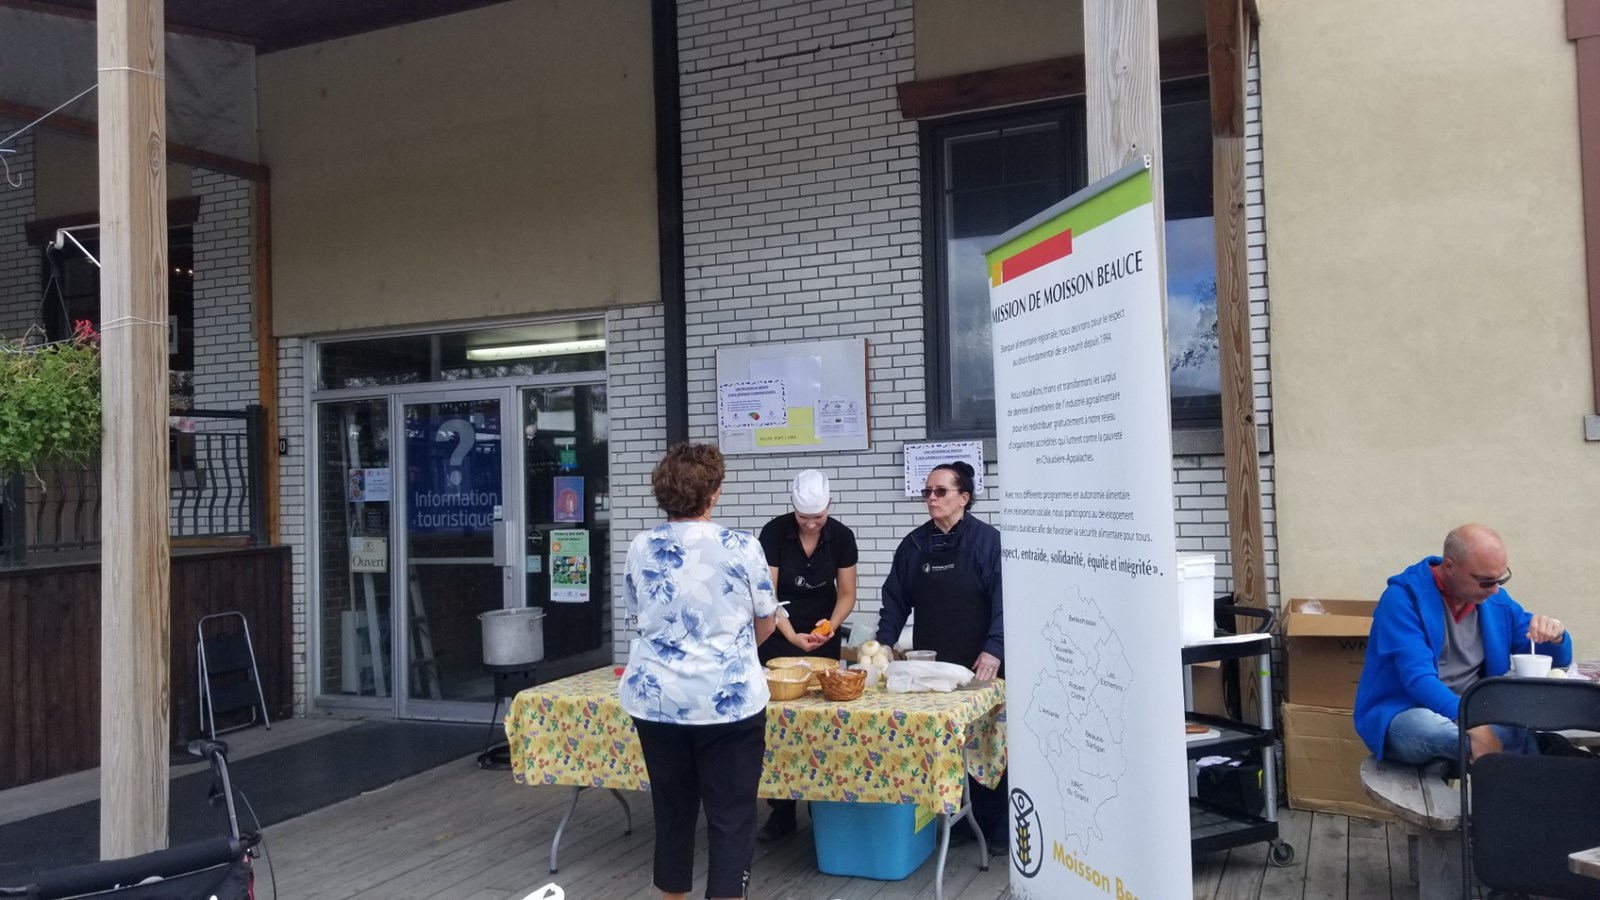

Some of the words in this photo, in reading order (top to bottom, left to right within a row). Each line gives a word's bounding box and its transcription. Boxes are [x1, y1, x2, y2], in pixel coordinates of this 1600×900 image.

[992, 297, 1026, 324] MISSION
[1028, 290, 1041, 312] DE
[1043, 270, 1094, 307] MOISSON
[1097, 250, 1143, 288] BEAUCE
[1015, 336, 1037, 349] alimentaire
[1058, 326, 1070, 336] nous
[1091, 317, 1102, 328] pour
[1103, 313, 1107, 323] le
[1107, 309, 1125, 322] respect
[1055, 346, 1061, 356] de
[1084, 336, 1099, 349] depuis
[1100, 371, 1116, 384] surplus
[1007, 409, 1013, 417] de
[1055, 400, 1061, 410] de
[1012, 425, 1022, 434] pour
[1053, 417, 1084, 430] gratuitement
[1088, 414, 1100, 423] notre
[1066, 435, 1082, 445] luttent
[1083, 435, 1097, 444] contre
[415, 489, 498, 507] Information
[1005, 491, 1014, 499] Avec
[1043, 491, 1072, 501] programmes
[1073, 491, 1079, 499] en
[1080, 489, 1105, 499] autonomie
[1105, 489, 1130, 500] alimentaire
[417, 510, 494, 530] touristique
[1052, 509, 1064, 517] nous
[1064, 508, 1091, 520] participons
[1092, 511, 1098, 519] au
[1019, 524, 1038, 533] durables
[1046, 525, 1053, 534] de
[1052, 525, 1073, 536] favoriser
[1098, 528, 1122, 540] alimentaire
[1123, 531, 1134, 542] pour
[1135, 532, 1153, 542] tous.
[352, 555, 385, 568] Ouvert
[1021, 548, 1049, 564] entraide,
[1050, 549, 1086, 569] solidarité,
[1087, 552, 1109, 573] équité
[1110, 557, 1117, 571] et
[1106, 670, 1116, 679] Les
[1053, 839, 1110, 894] Moisson
